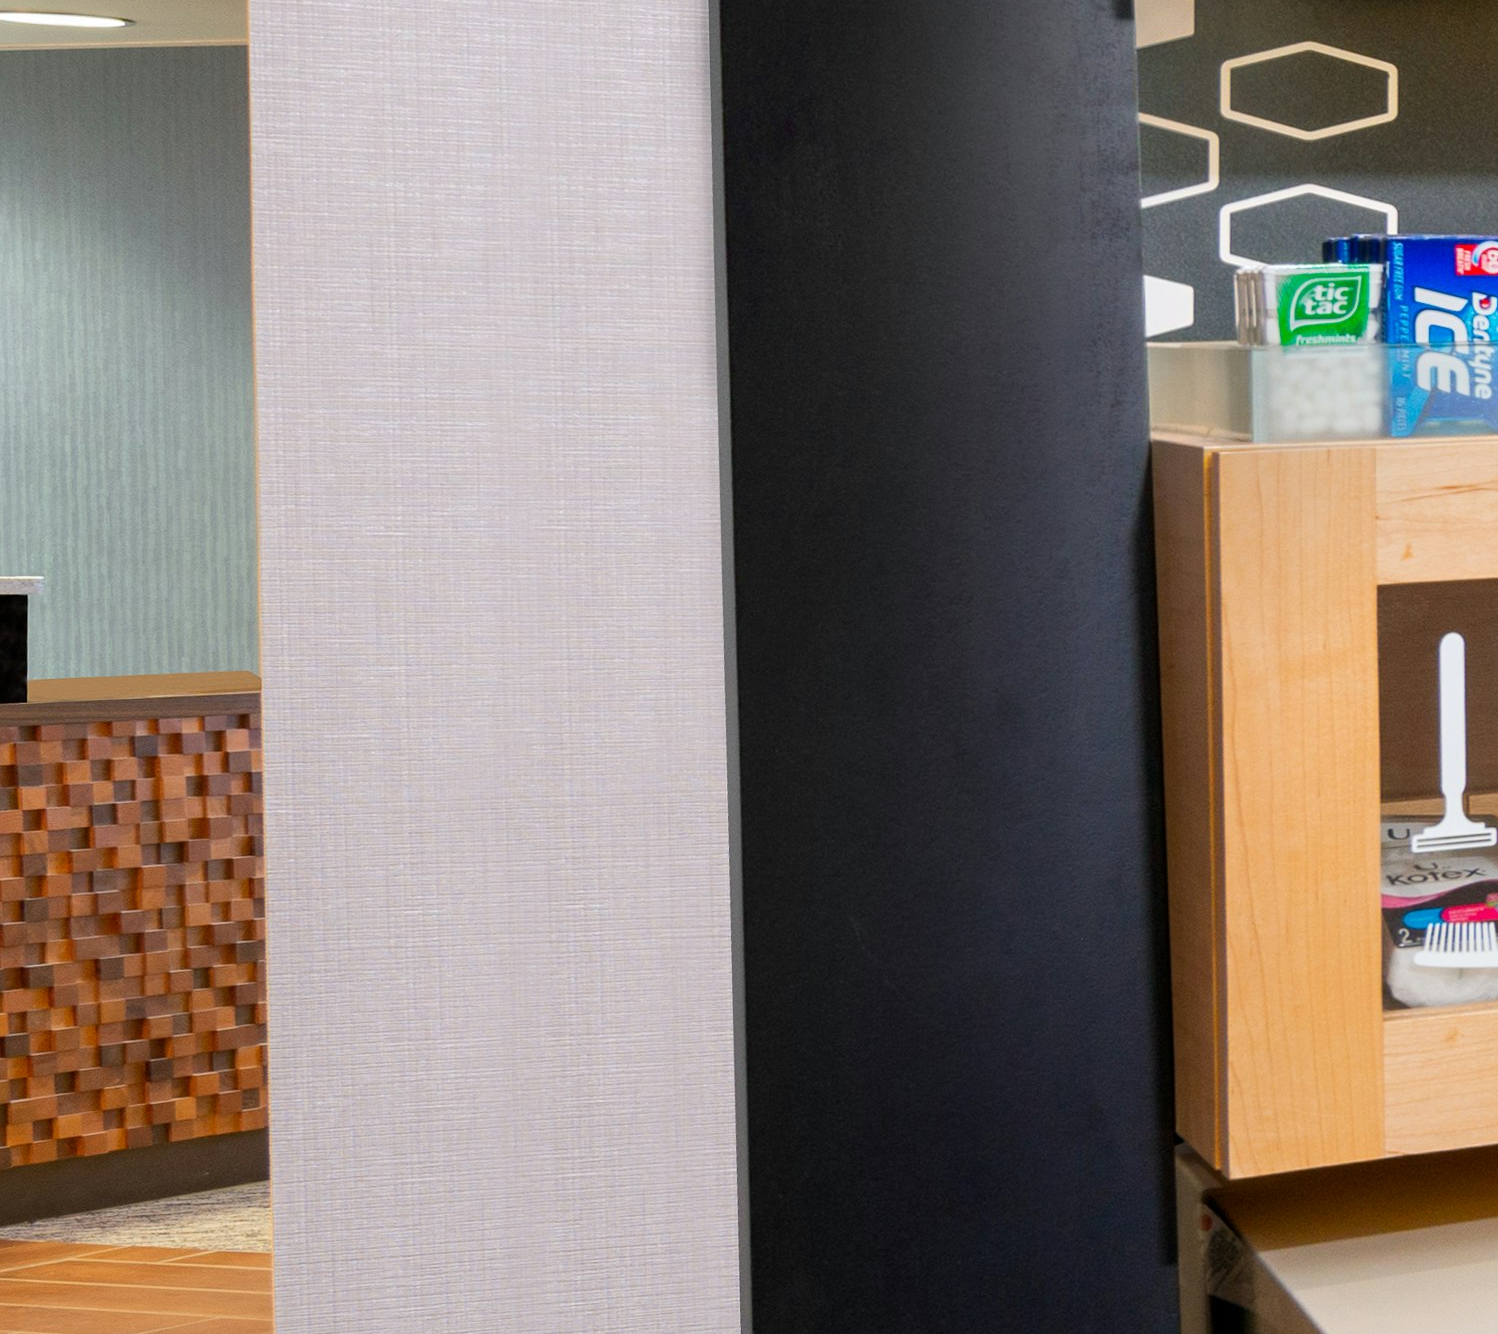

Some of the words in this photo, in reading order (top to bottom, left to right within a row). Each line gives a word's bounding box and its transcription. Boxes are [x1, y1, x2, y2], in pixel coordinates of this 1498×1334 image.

[1312, 283, 1350, 302] tic
[1303, 298, 1348, 316] tac
[1295, 333, 1357, 346] freshmints
[1414, 286, 1471, 397] ICE
[1469, 291, 1498, 400] Dentyne
[1386, 865, 1488, 887] Kotex
